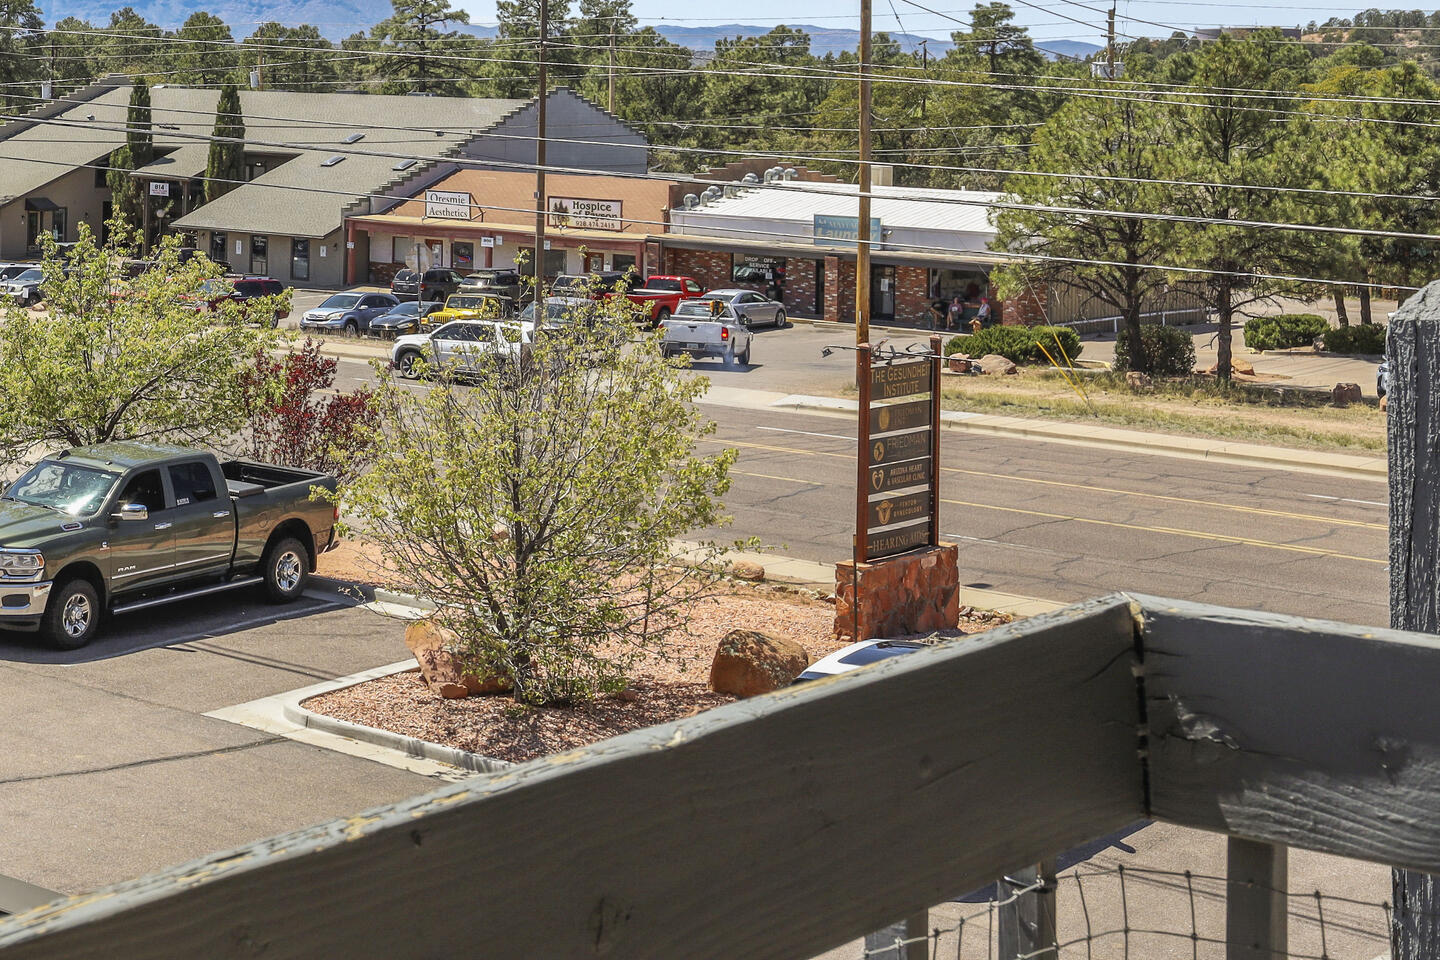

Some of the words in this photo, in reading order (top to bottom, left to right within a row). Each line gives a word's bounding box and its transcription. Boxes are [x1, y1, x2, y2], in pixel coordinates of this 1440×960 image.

[429, 206, 468, 218] Aesthetics
[572, 200, 612, 212] Hospice
[871, 369, 887, 384] THE
[884, 381, 920, 397] INSTITUTE
[873, 535, 909, 552] HEARING
[117, 565, 137, 573] RAM
